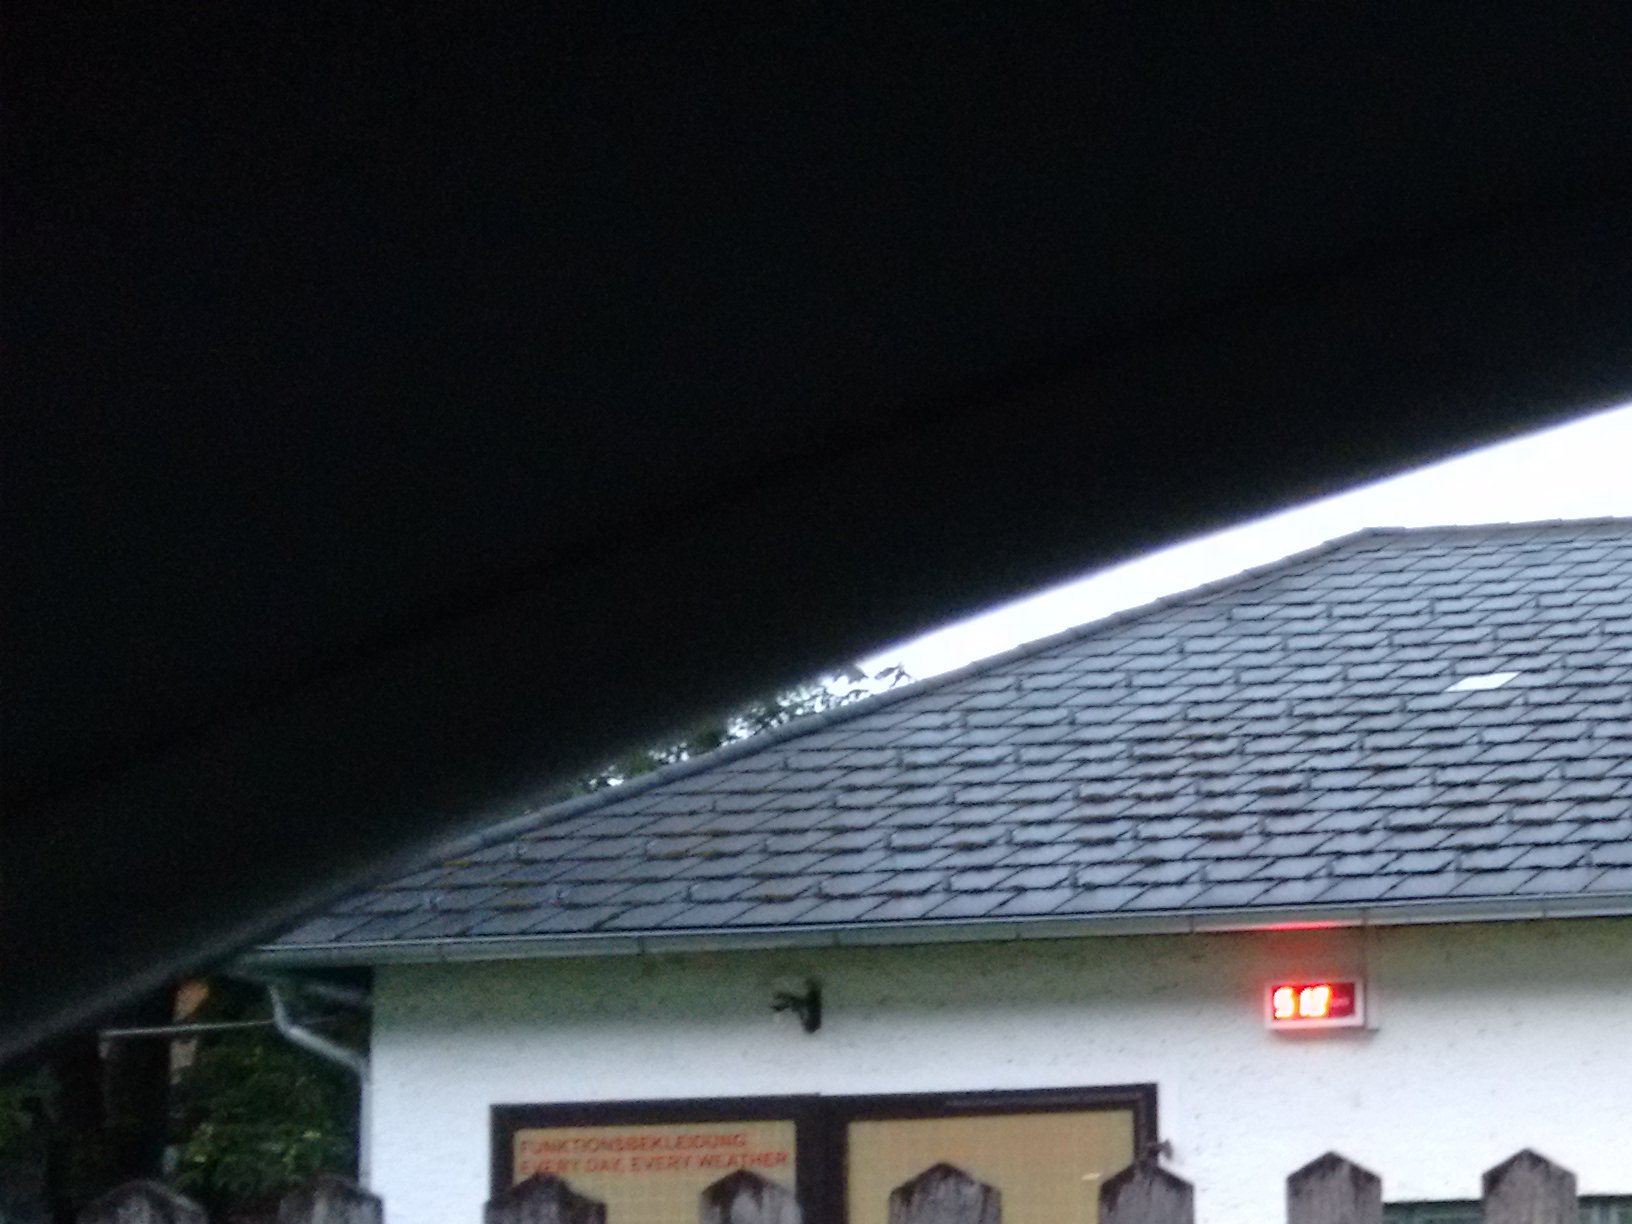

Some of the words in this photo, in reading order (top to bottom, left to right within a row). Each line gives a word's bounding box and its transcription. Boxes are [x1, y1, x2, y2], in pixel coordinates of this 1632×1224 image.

[519, 1133, 747, 1155] FUNKTIONSBEKLEIDUNG
[519, 1157, 581, 1175] EVERY
[630, 1155, 690, 1173] EVERY
[697, 1151, 789, 1170] WEATHER
